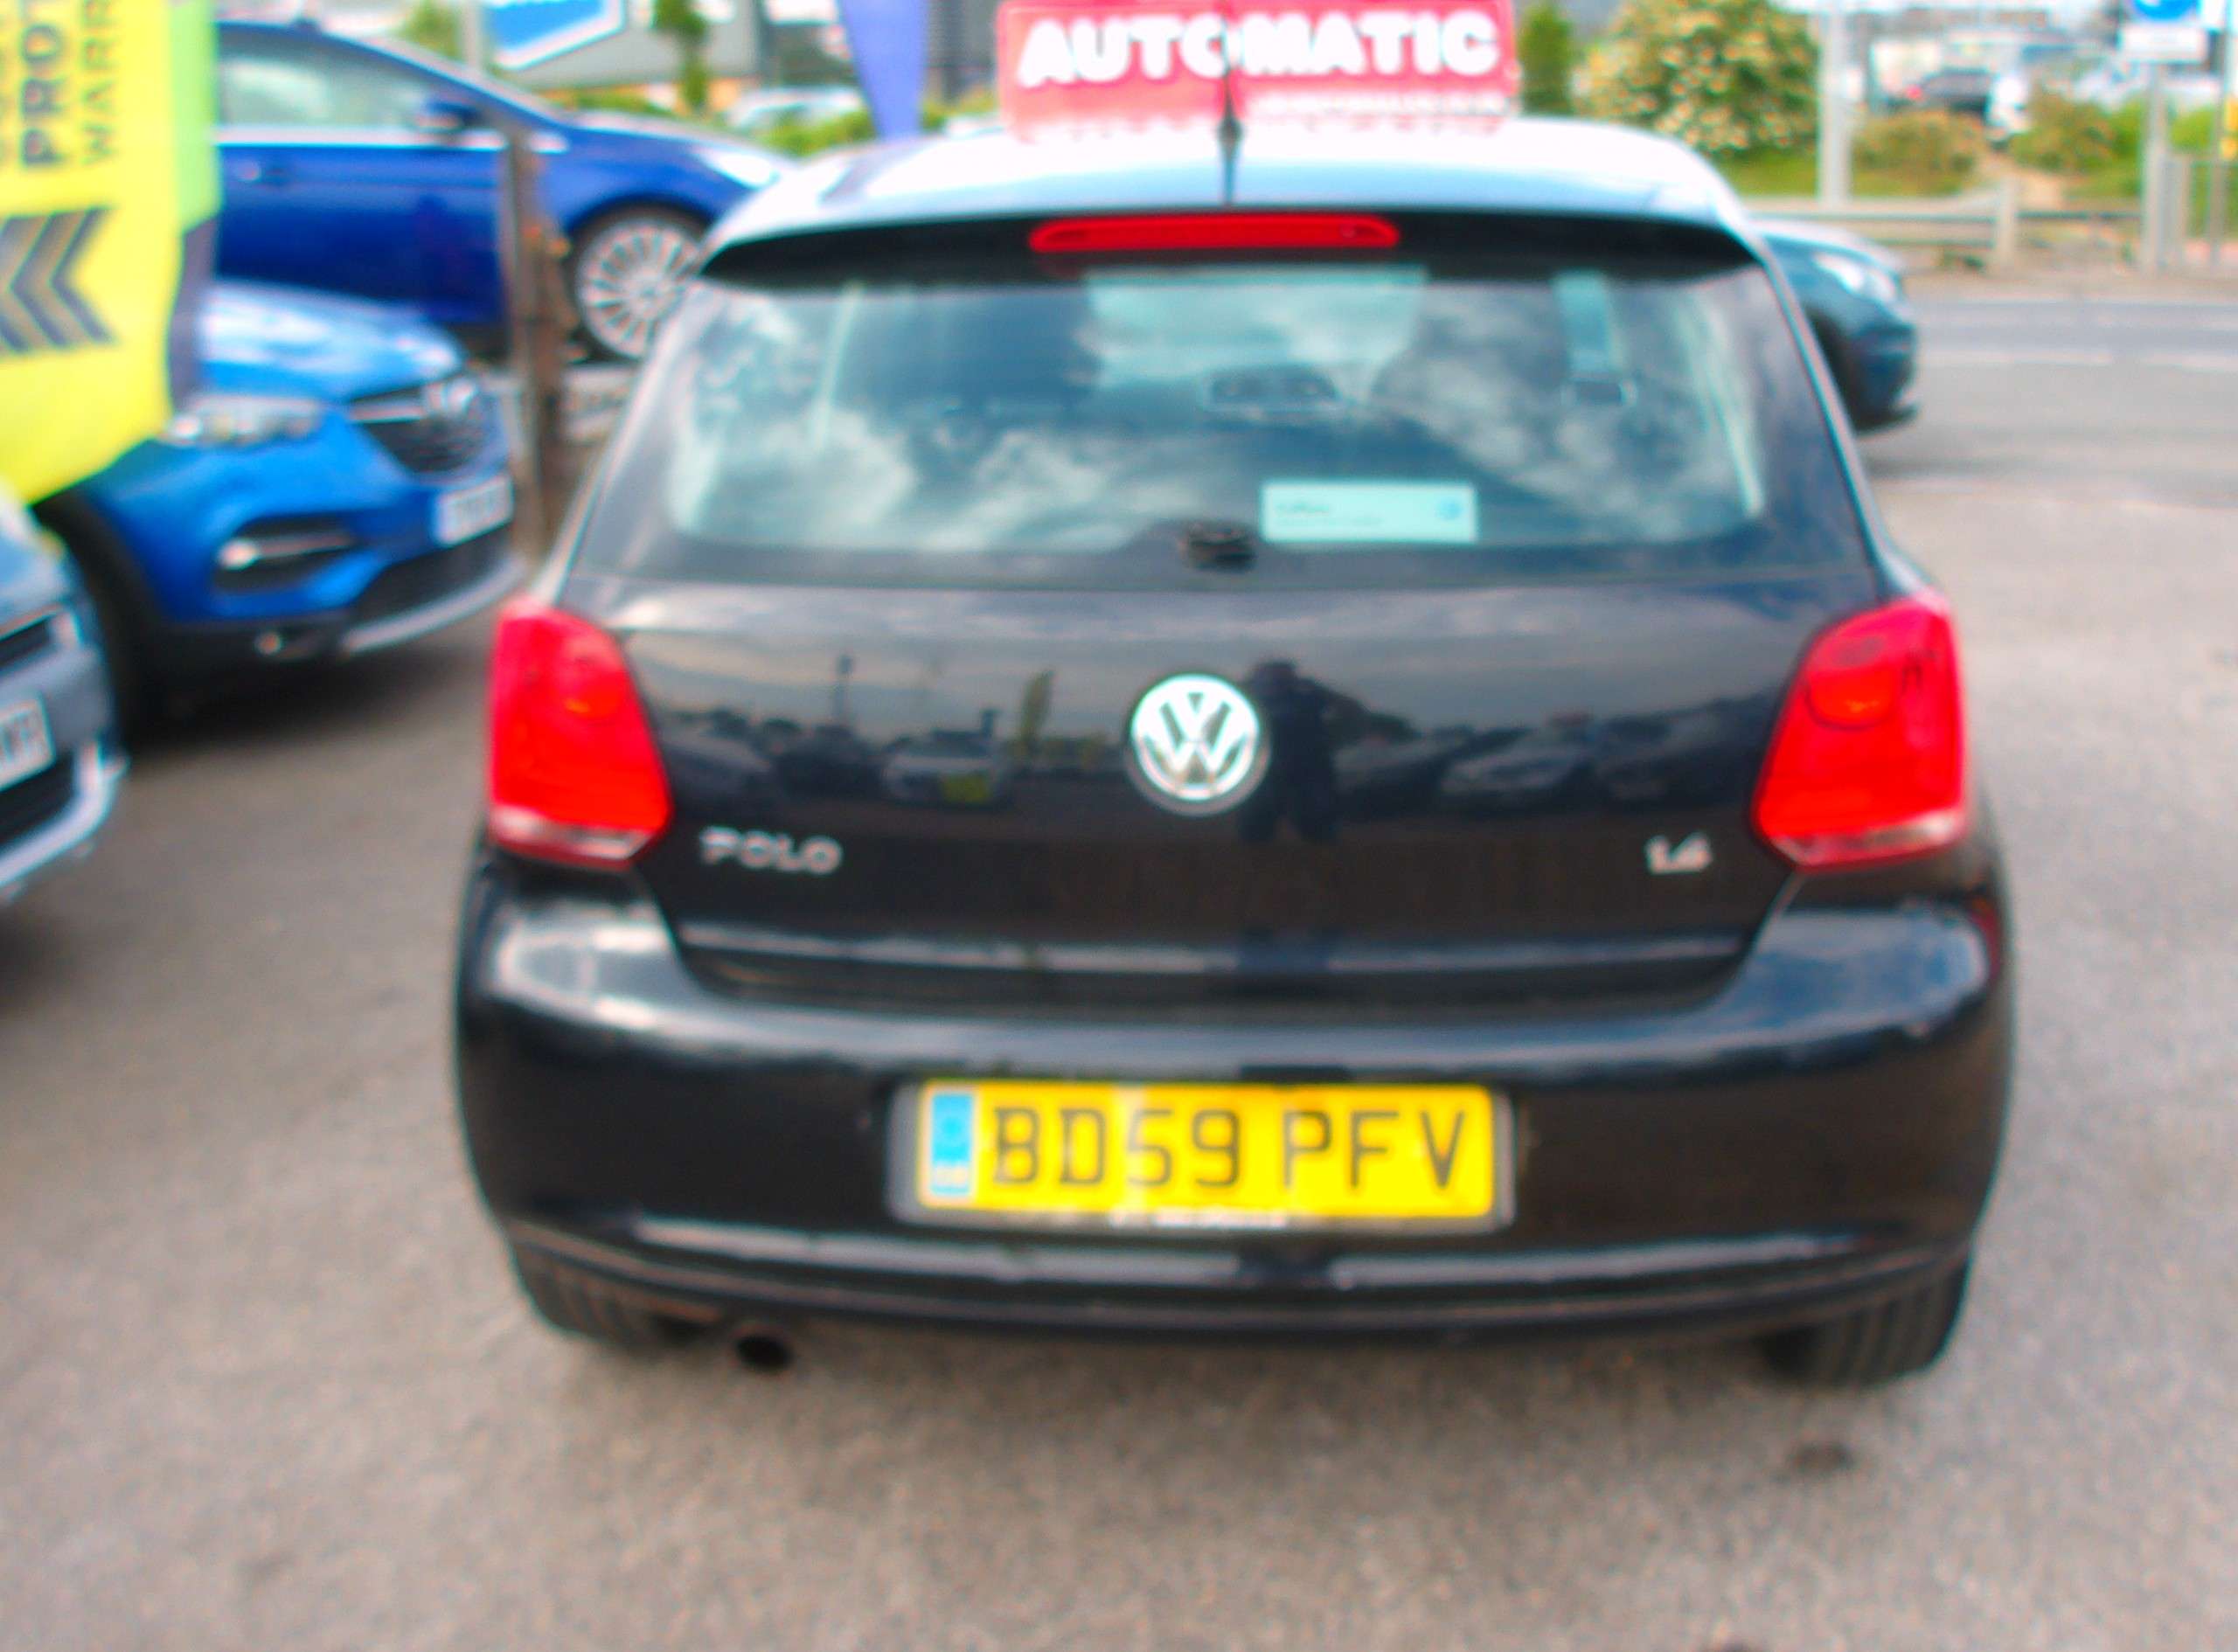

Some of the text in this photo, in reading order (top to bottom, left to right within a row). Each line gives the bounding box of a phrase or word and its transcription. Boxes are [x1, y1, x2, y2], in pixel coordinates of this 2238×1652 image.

[1017, 10, 1500, 87] AUTOMATIC
[701, 828, 843, 874] POLO
[993, 1107, 1466, 1190] BD59 PFV
